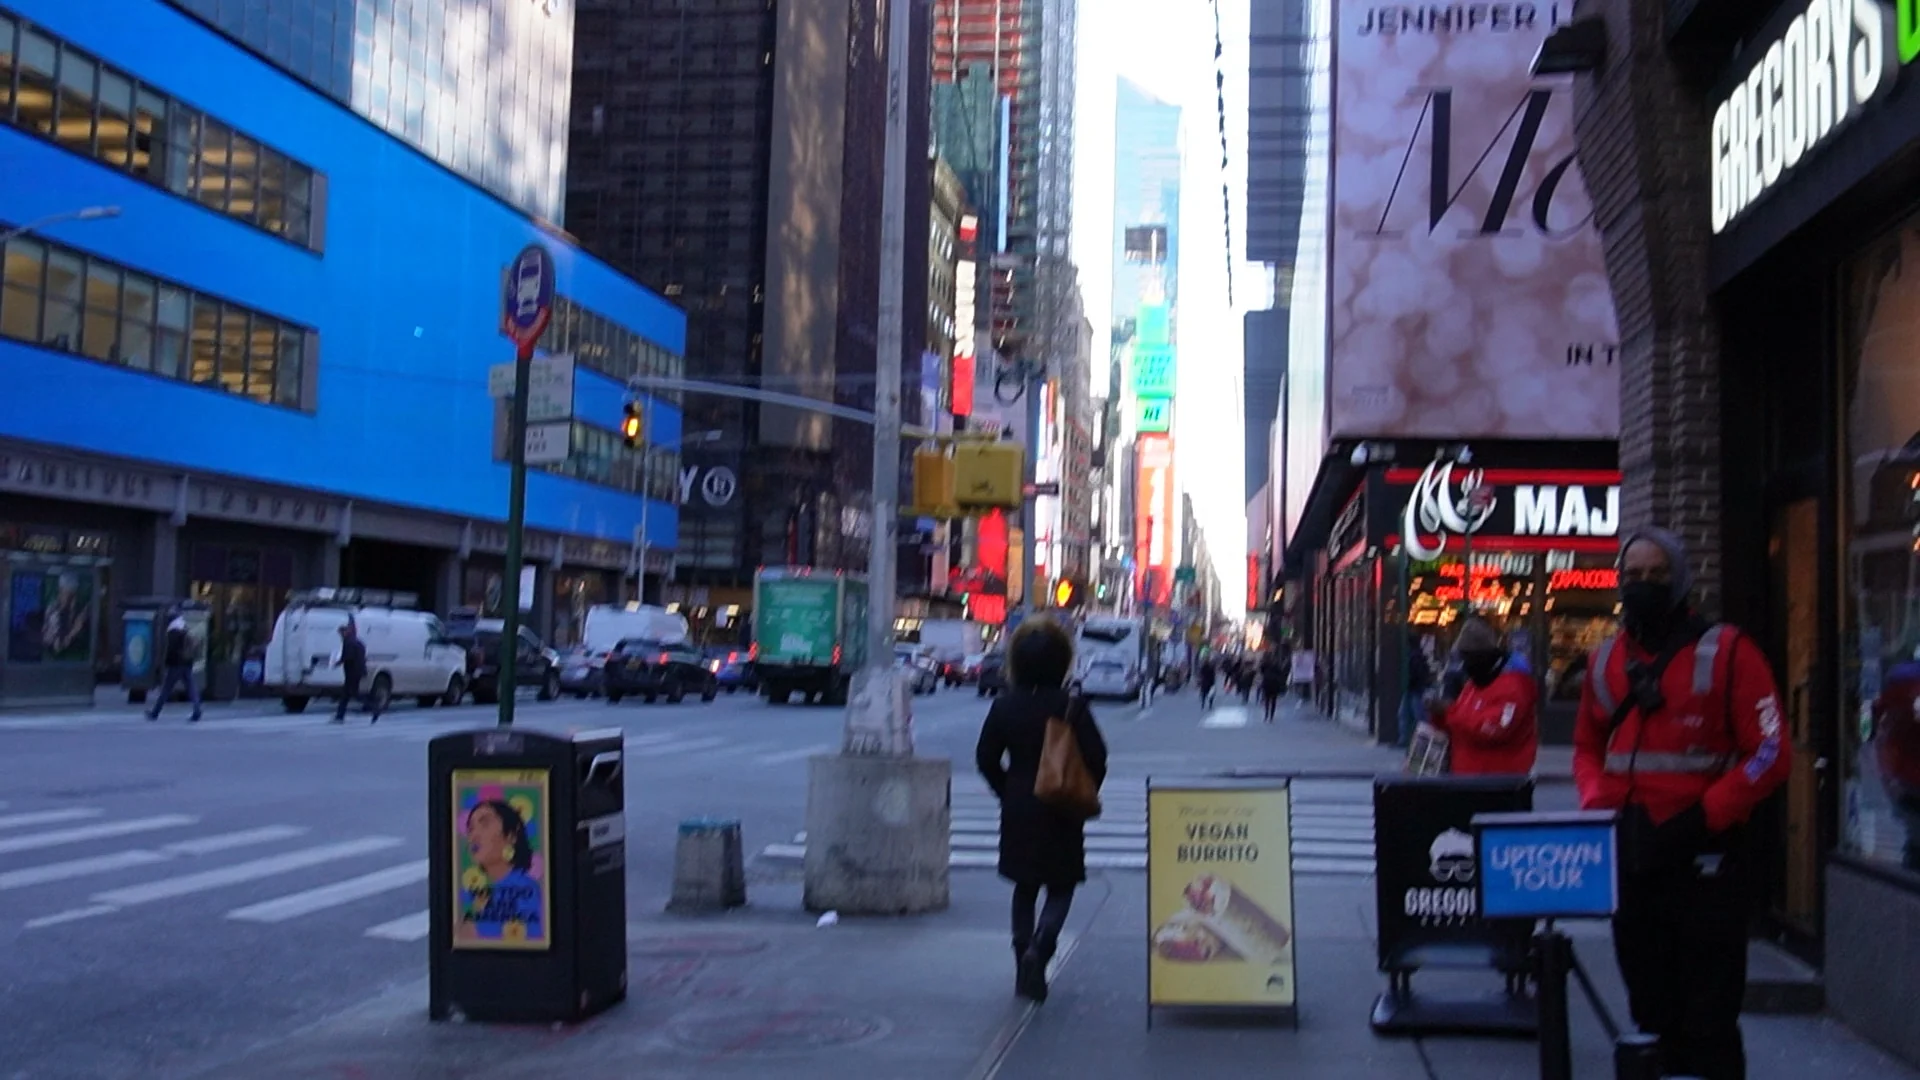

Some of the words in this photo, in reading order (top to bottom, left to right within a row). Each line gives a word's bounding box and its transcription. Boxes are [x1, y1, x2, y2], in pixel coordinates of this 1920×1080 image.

[1357, 2, 1536, 36] JENNIFER
[1711, 0, 1884, 234] GREGORYS
[1565, 343, 1594, 366] IN
[1513, 485, 1621, 536] MAJ
[1185, 822, 1249, 841] VEGAN
[1177, 843, 1259, 864] BURRITO
[1491, 842, 1603, 871] UPTOWN
[1511, 863, 1583, 891] TOUR
